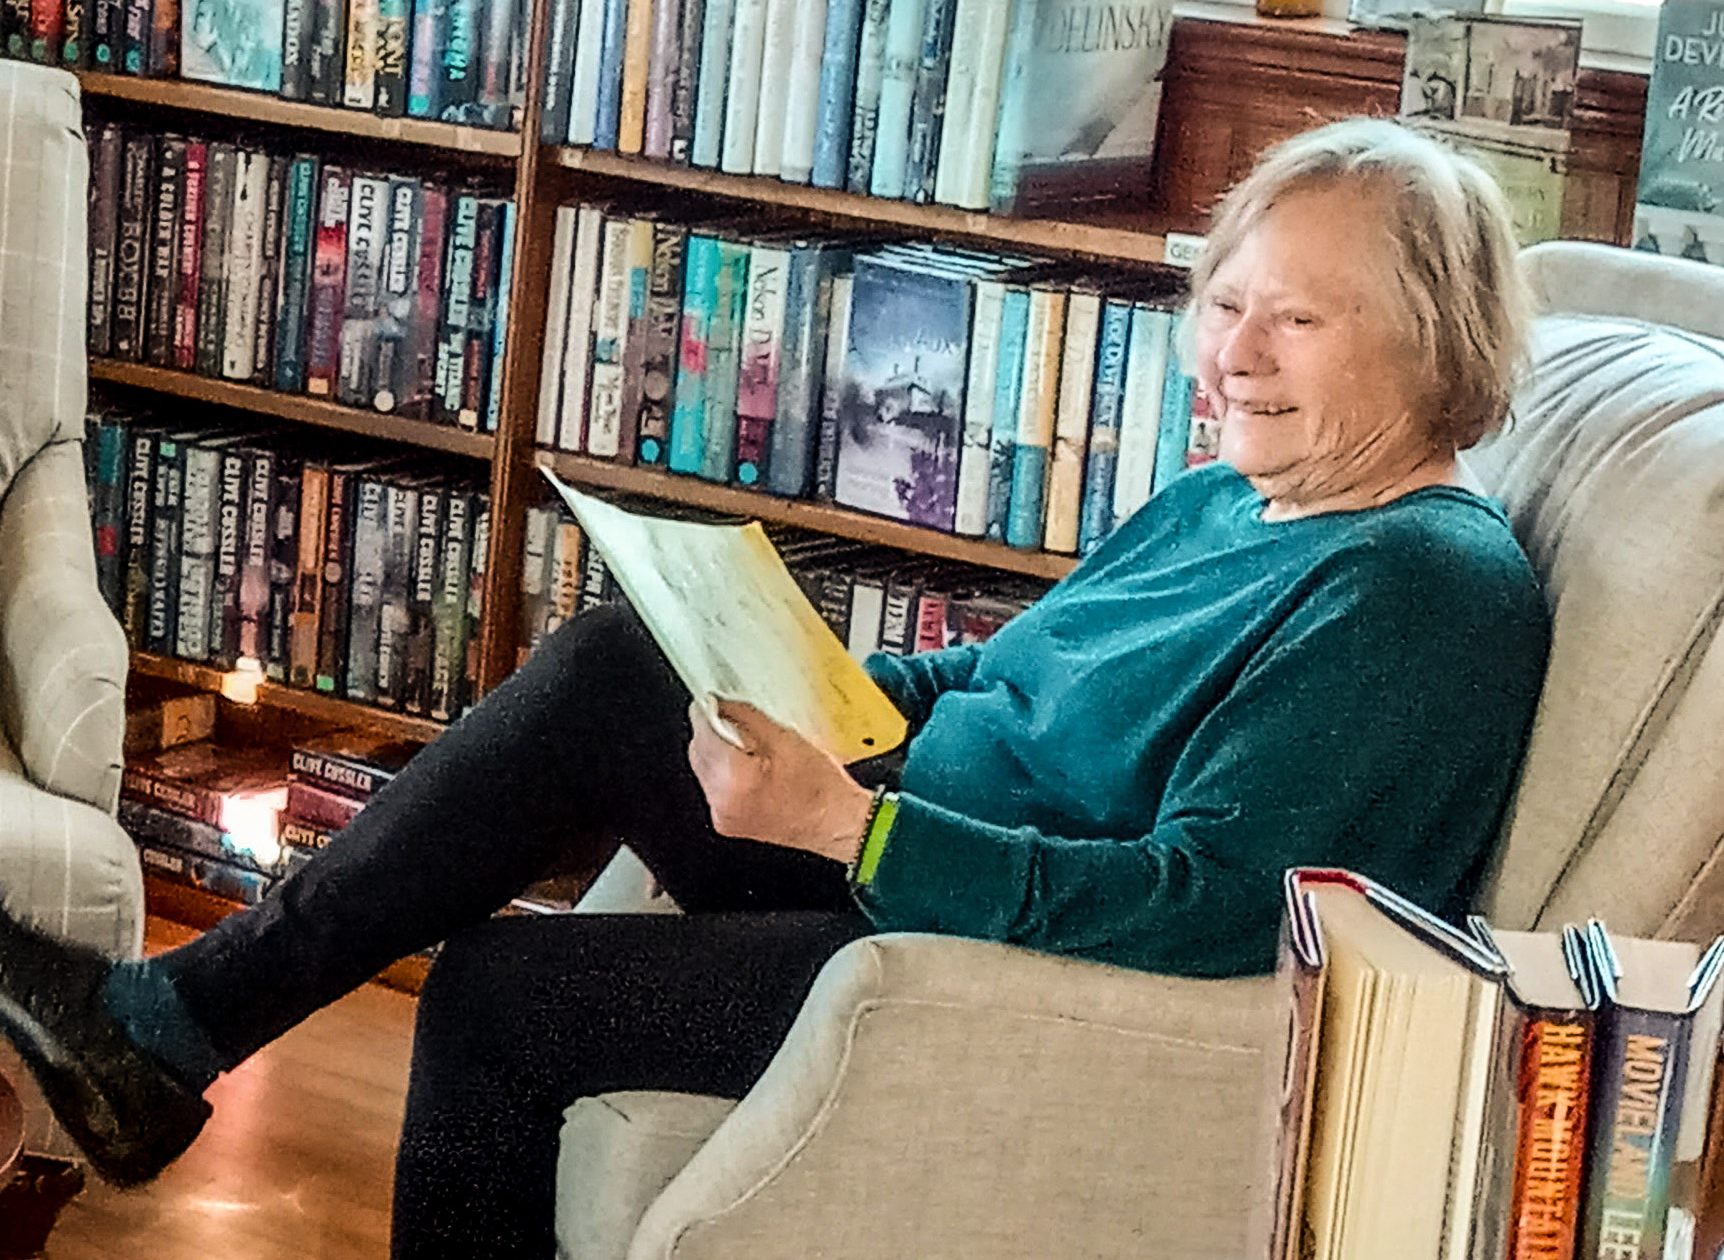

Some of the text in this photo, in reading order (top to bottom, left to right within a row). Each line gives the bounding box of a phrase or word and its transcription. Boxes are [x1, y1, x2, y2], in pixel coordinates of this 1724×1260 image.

[1668, 86, 1693, 119] A
[161, 167, 176, 177] A
[393, 186, 414, 230] CLIVE
[350, 184, 375, 310] CLIVE CUSSL
[455, 197, 478, 248] CLIVE
[129, 438, 152, 545] CLIVE CUSSLER
[219, 457, 242, 576] CLIVE CUSSLER
[248, 459, 271, 567] CLIVE CUSSLER
[447, 500, 465, 540] CLIVE
[416, 495, 438, 601] CLIVE CUSSLER
[292, 752, 372, 791] CLIVE CUSSLER
[1536, 1023, 1585, 1107] HAWK
[1607, 1034, 1666, 1199] MOVIELAND
